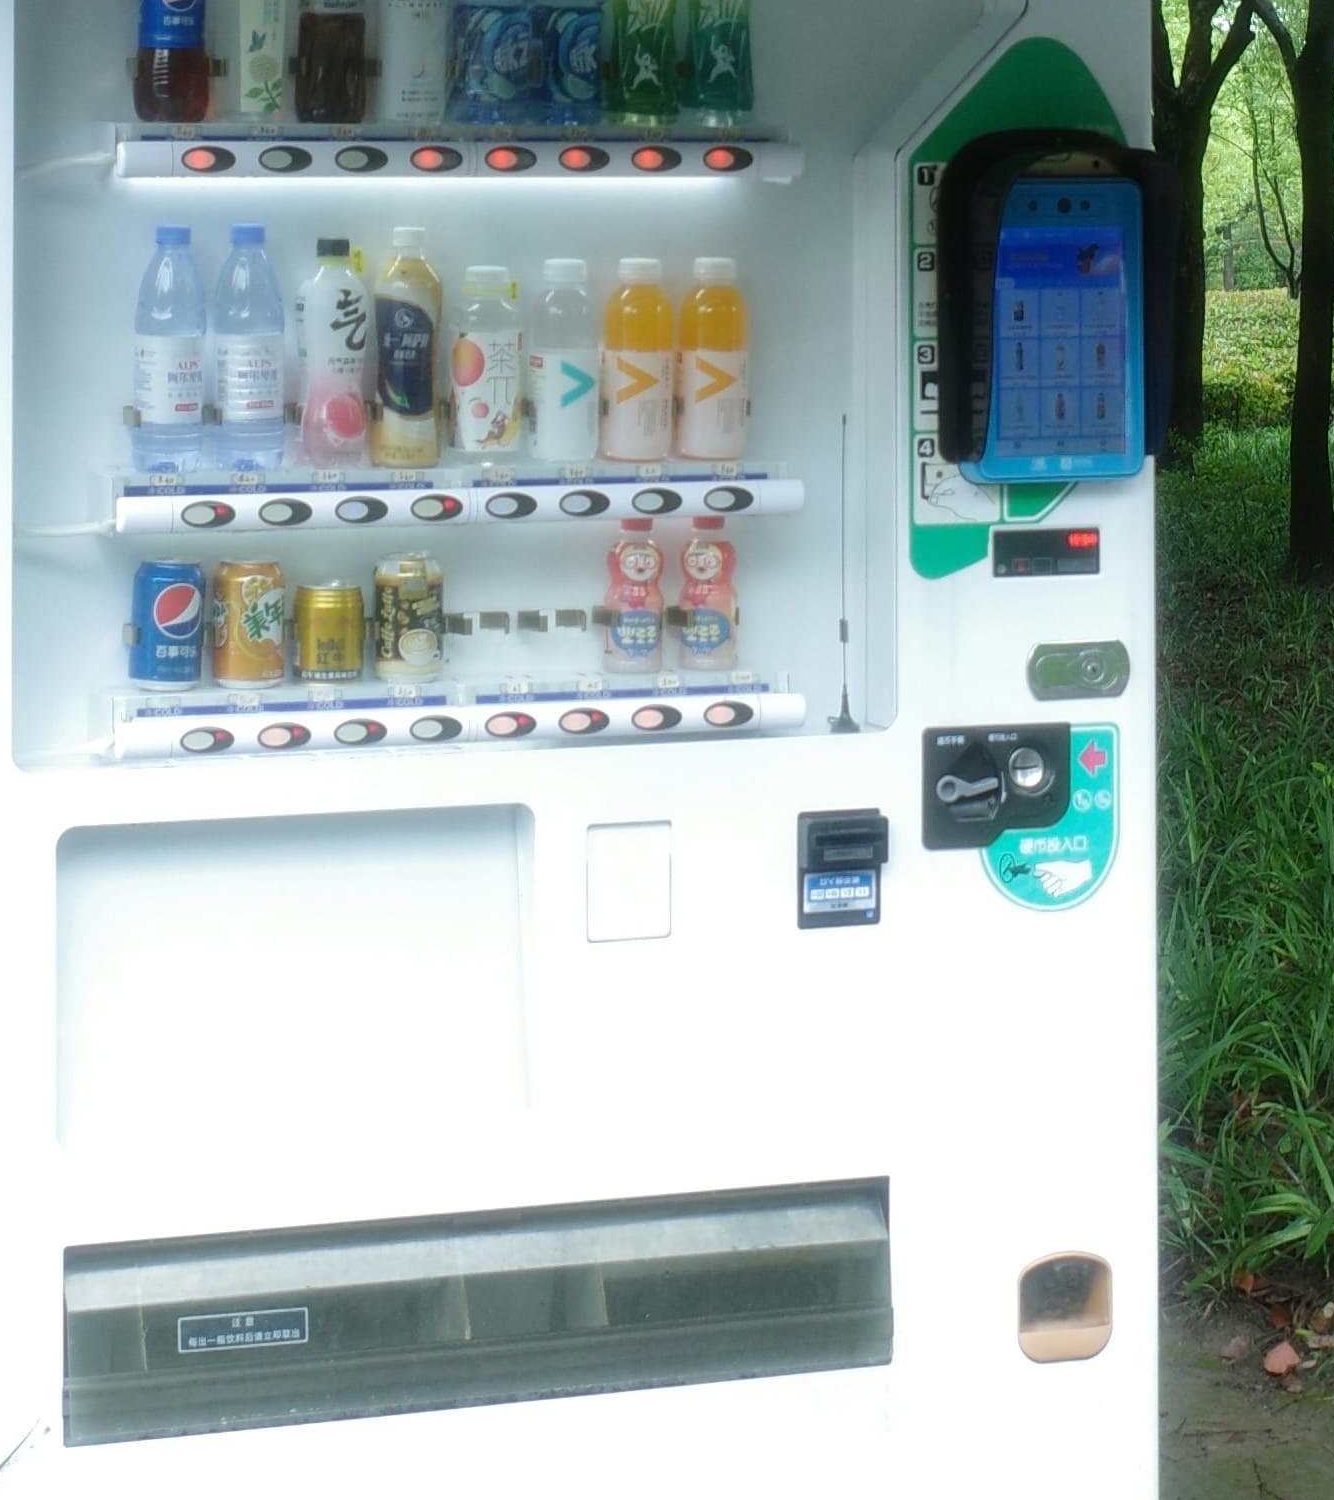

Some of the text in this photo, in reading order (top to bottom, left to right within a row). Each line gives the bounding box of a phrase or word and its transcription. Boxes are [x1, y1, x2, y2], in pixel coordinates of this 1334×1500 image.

[920, 254, 932, 270] 2
[331, 289, 367, 350] 气
[920, 347, 932, 362] 3
[919, 440, 932, 456] 4
[156, 644, 197, 659] 百事可乐
